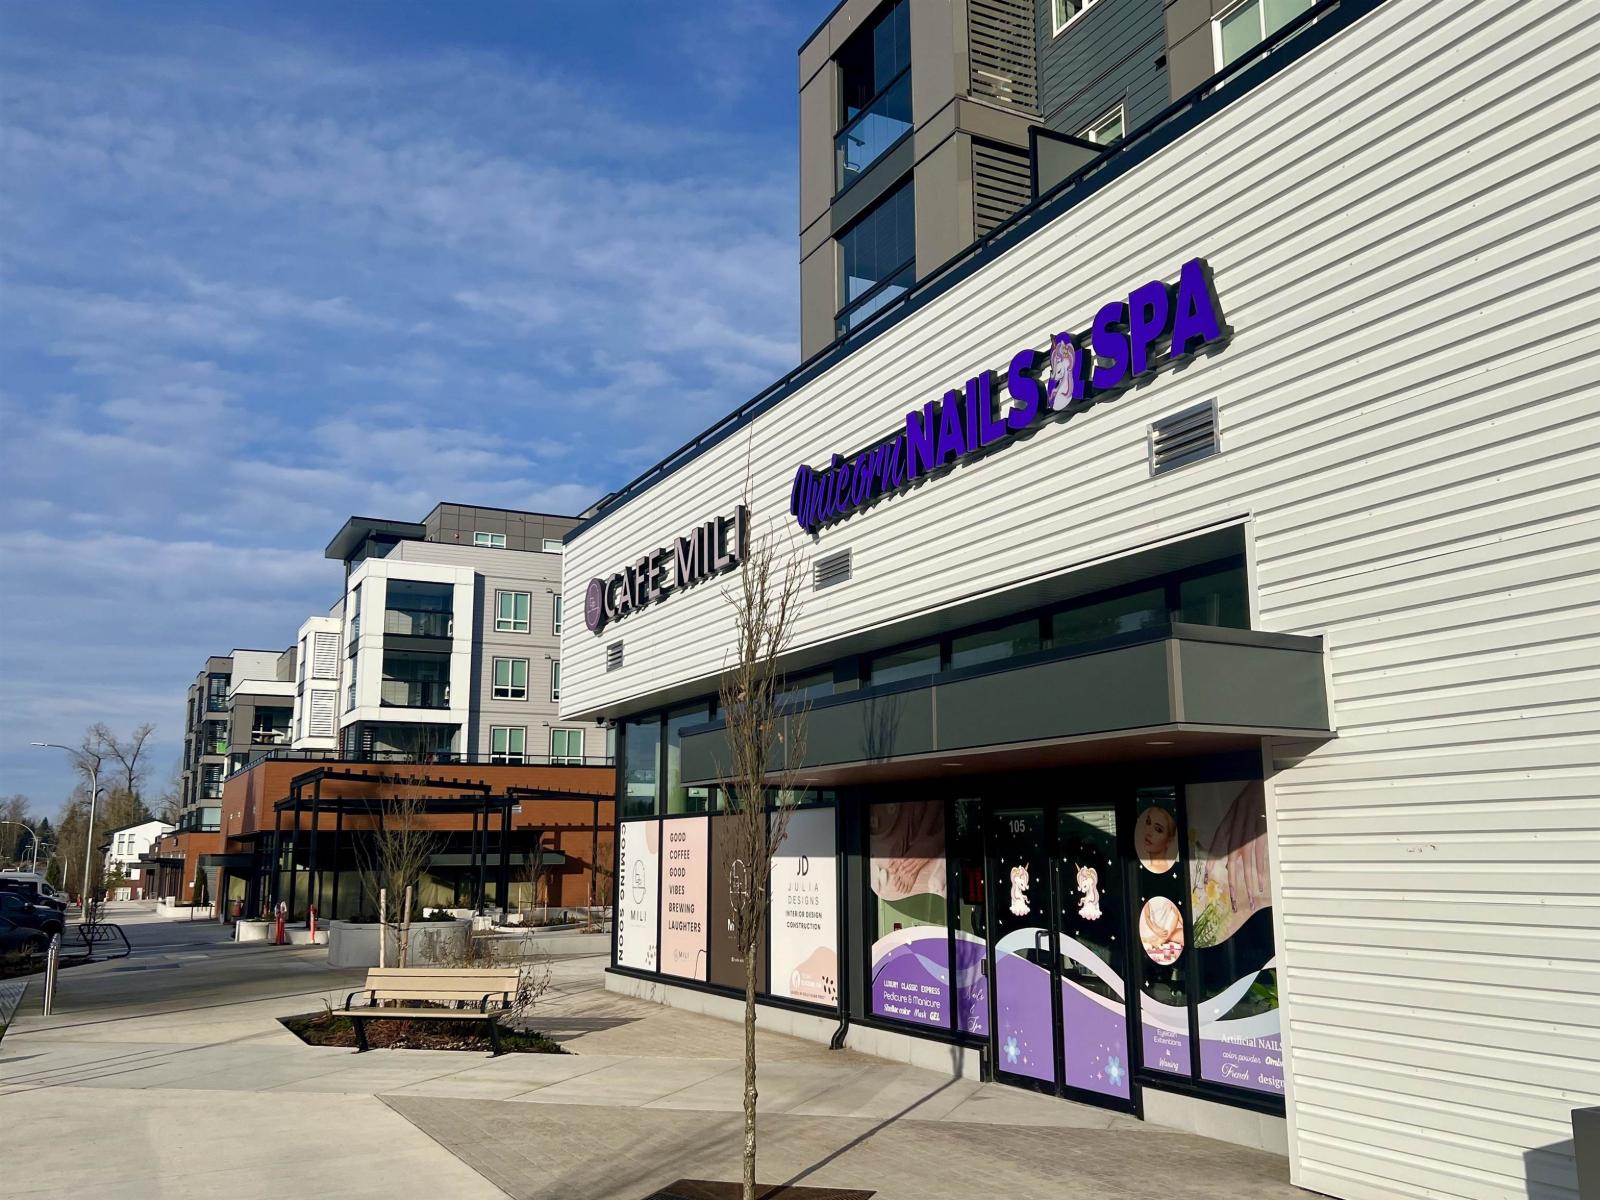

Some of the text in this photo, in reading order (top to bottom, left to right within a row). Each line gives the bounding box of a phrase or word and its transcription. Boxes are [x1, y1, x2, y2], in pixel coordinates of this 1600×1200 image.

[790, 435, 906, 535] Unicorn
[906, 349, 1040, 481] NAILS
[1091, 256, 1222, 390] SPA
[604, 504, 745, 618] CAFE MILI
[1009, 819, 1026, 833] 105
[669, 832, 687, 842] GOOD
[669, 850, 690, 860] COFFEE
[619, 823, 627, 901] COMING
[796, 855, 809, 876] JD
[669, 867, 686, 877] GOOD
[669, 885, 685, 895] VIBES
[787, 882, 820, 892] JULIA
[787, 895, 820, 906] DESIGNS
[668, 902, 695, 914] BREWING
[630, 910, 647, 922] MILI
[785, 910, 823, 919] INTERIOR DESIGN
[668, 920, 701, 933] LAUGHTERS
[786, 921, 821, 930] CONSTRUCTION
[883, 979, 941, 996] LUXURY CLASSIC EXPRESS
[883, 991, 908, 1003] Pedicure
[912, 996, 941, 1009] Manicure
[929, 1012, 941, 1021] GEL
[1221, 1033, 1256, 1048] Artificial
[1221, 1062, 1249, 1080] French
